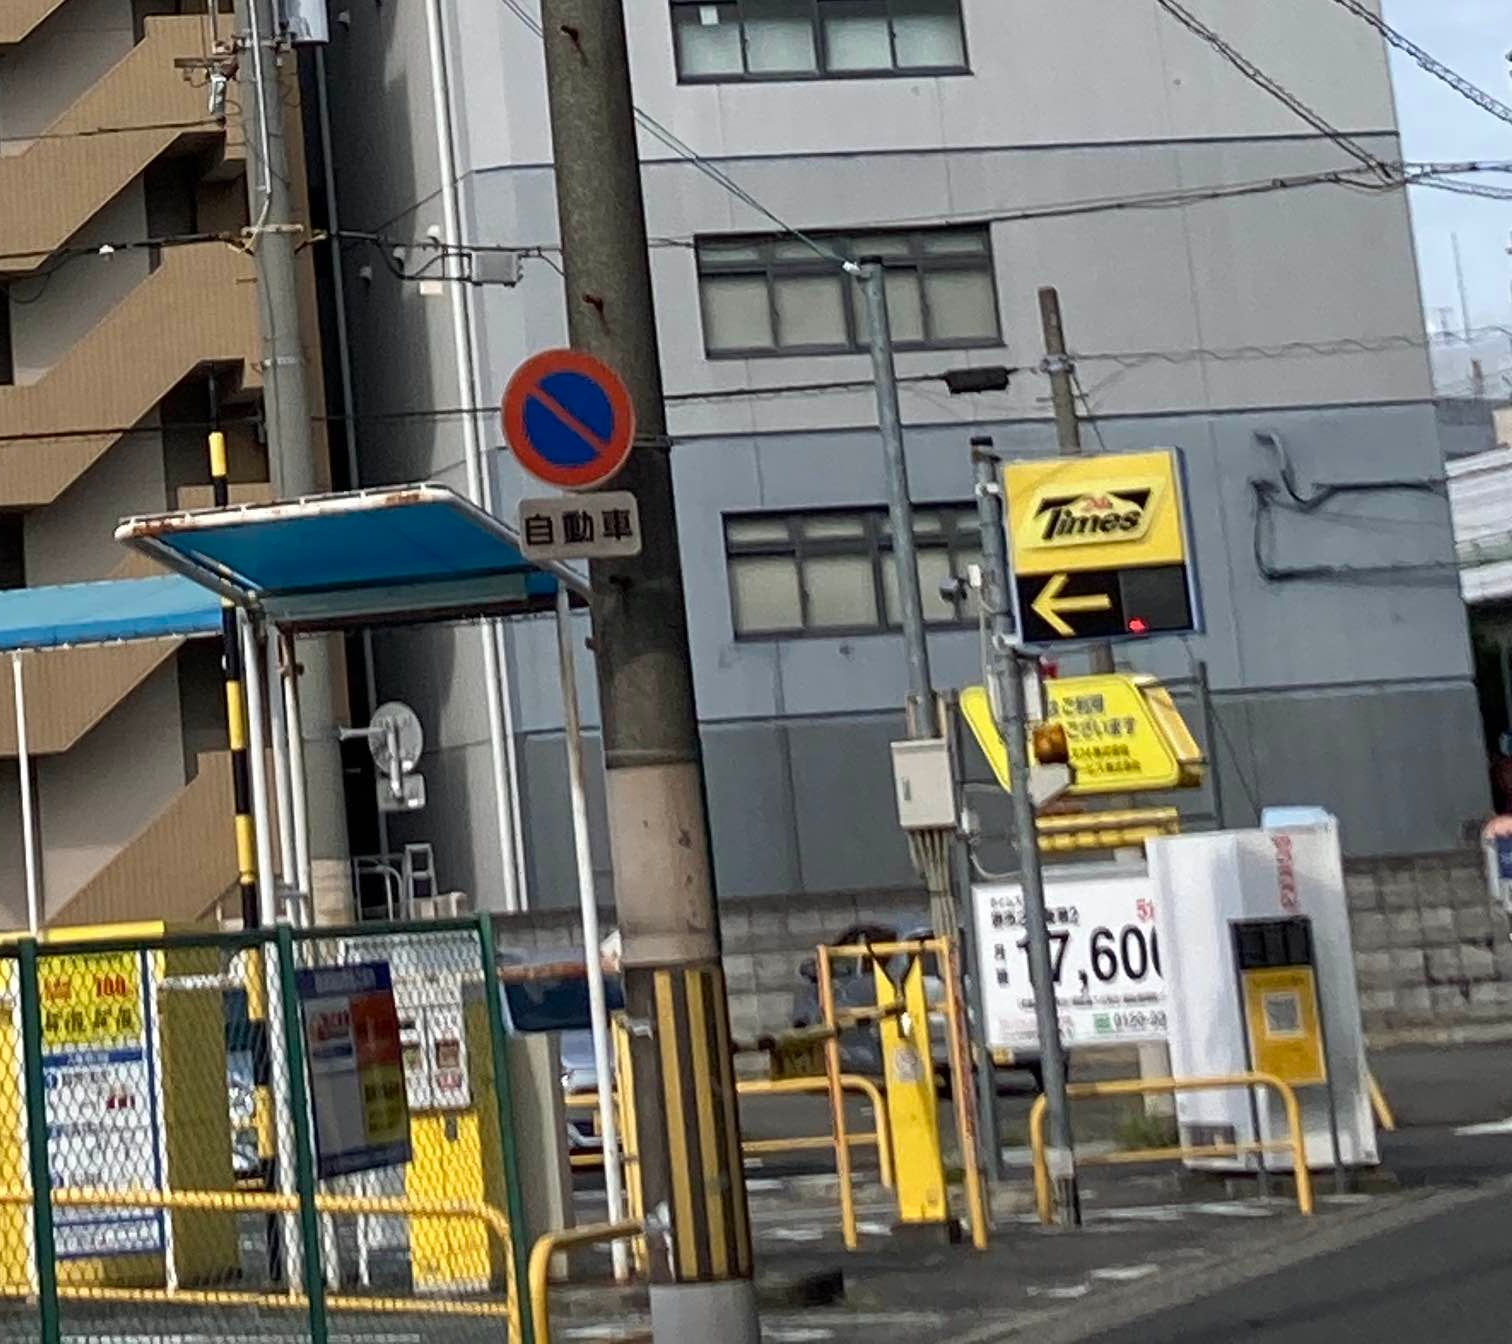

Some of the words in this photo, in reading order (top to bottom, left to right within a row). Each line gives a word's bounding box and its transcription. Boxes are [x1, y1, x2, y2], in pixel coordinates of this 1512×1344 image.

[525, 509, 633, 546] 自動車
[1036, 500, 1142, 540] Times
[1016, 924, 1163, 992] 7,60
